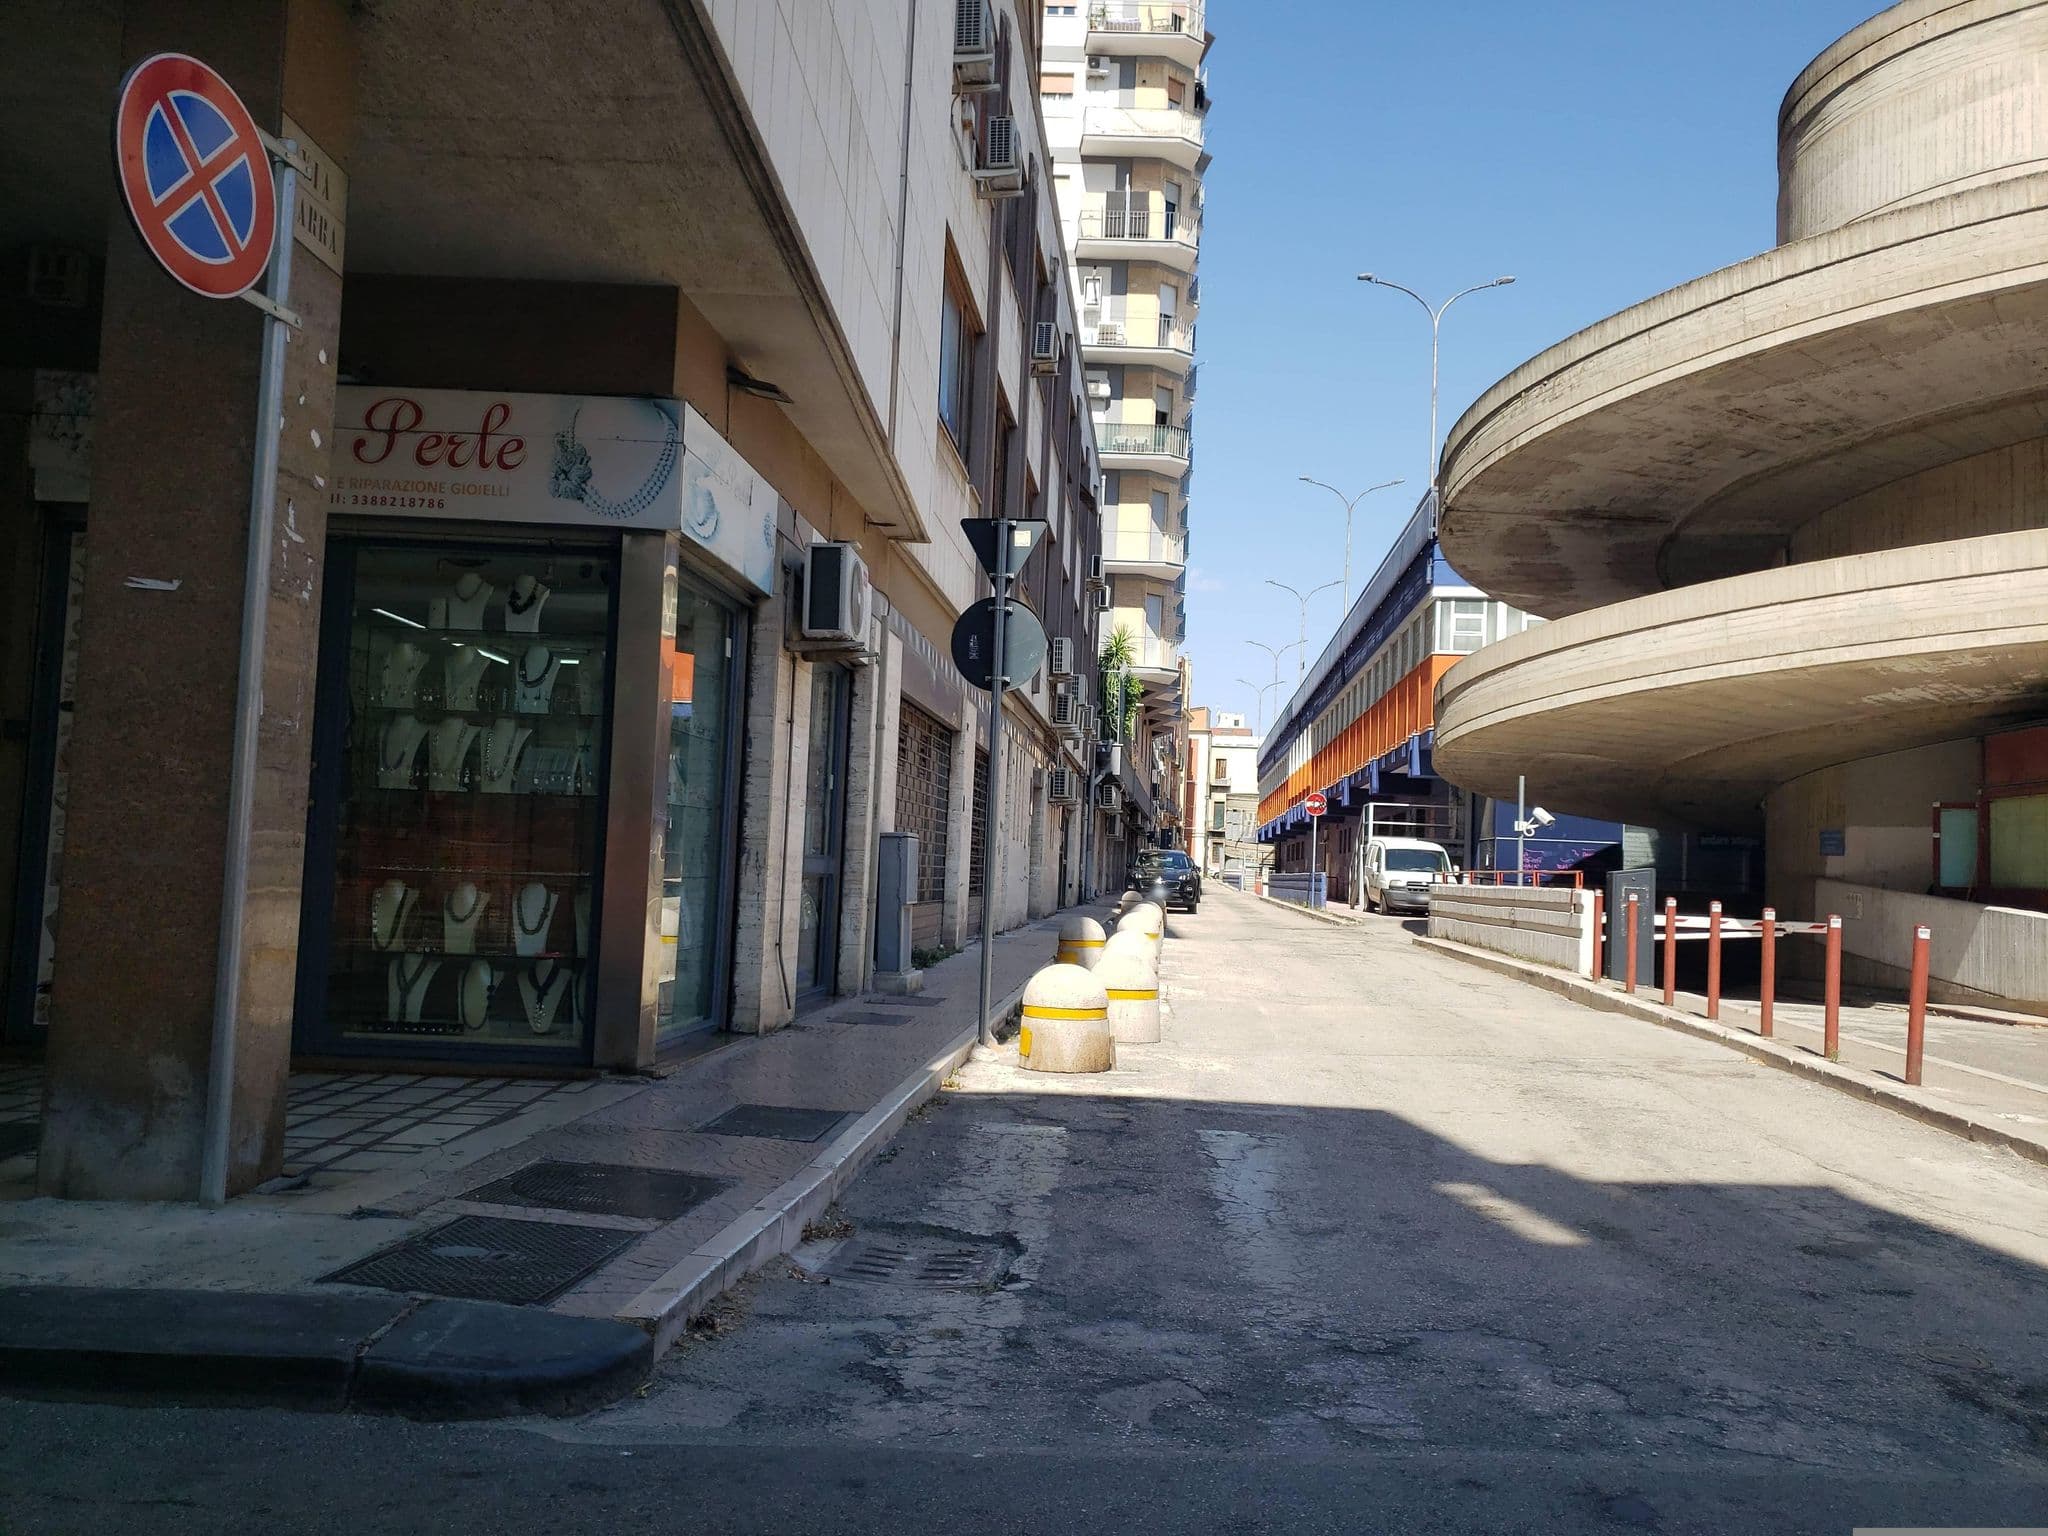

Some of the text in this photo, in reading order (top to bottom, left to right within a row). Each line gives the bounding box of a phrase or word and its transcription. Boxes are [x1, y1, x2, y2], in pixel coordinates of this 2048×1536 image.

[353, 398, 527, 471] Perle
[350, 477, 445, 495] RIPARAZIONE
[451, 482, 510, 497] GIOIELLI
[351, 494, 445, 509] 3388218786
